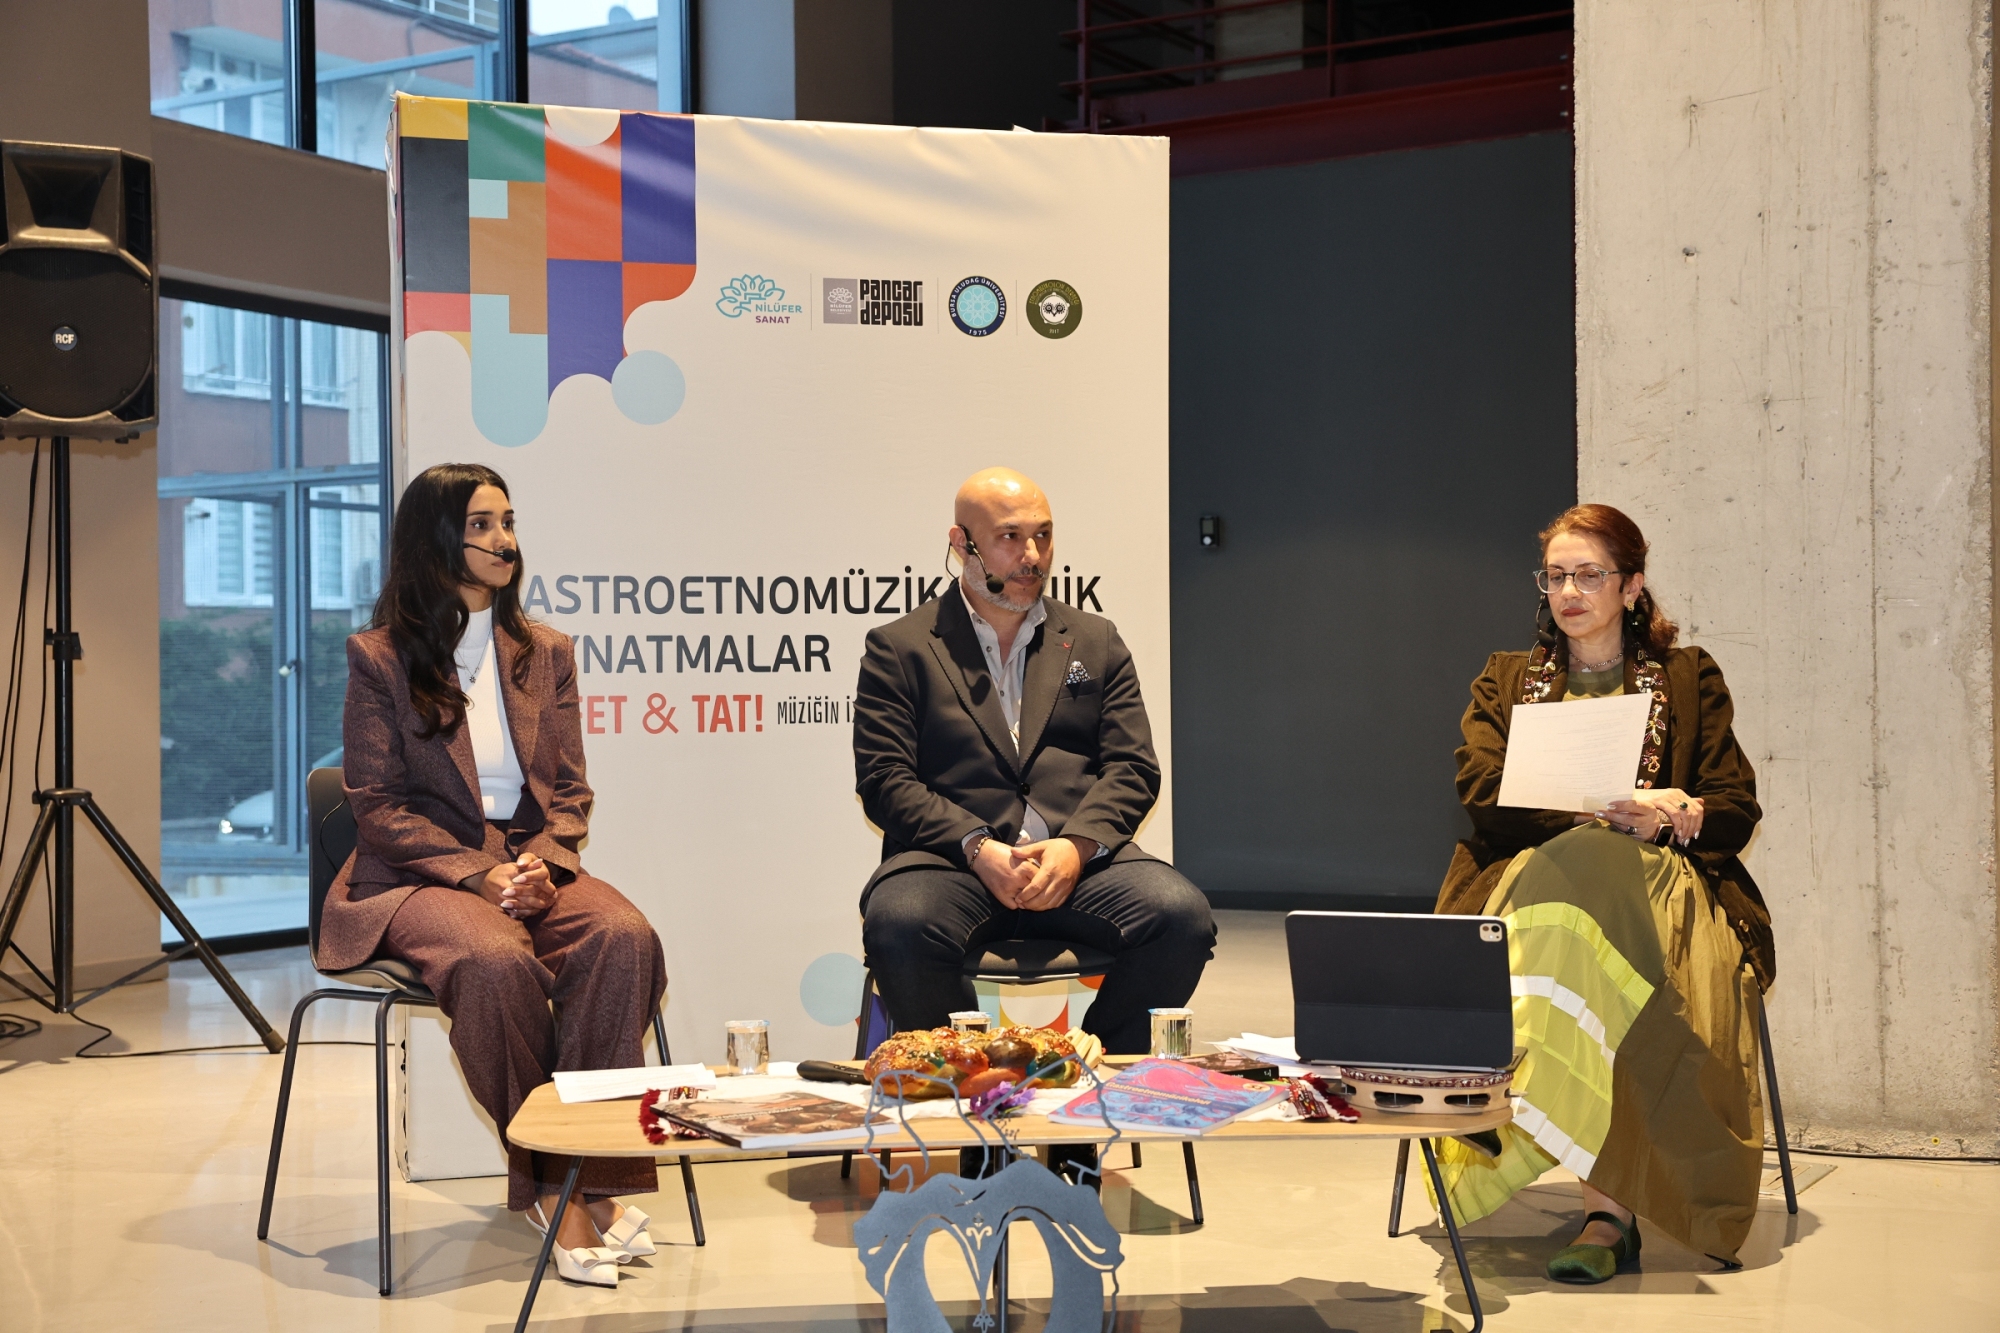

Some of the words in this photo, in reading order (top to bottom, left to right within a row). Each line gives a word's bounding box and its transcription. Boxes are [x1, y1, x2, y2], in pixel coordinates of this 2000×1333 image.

[954, 277, 980, 294] ULUDAĞ
[755, 302, 803, 313] NİLÜFER
[755, 315, 791, 324] SANAT
[55, 333, 75, 344] RCF
[574, 634, 832, 674] NATMALAR
[642, 692, 680, 735] &
[691, 694, 763, 733] TAT!
[777, 695, 840, 725] MÜZİĞİN
